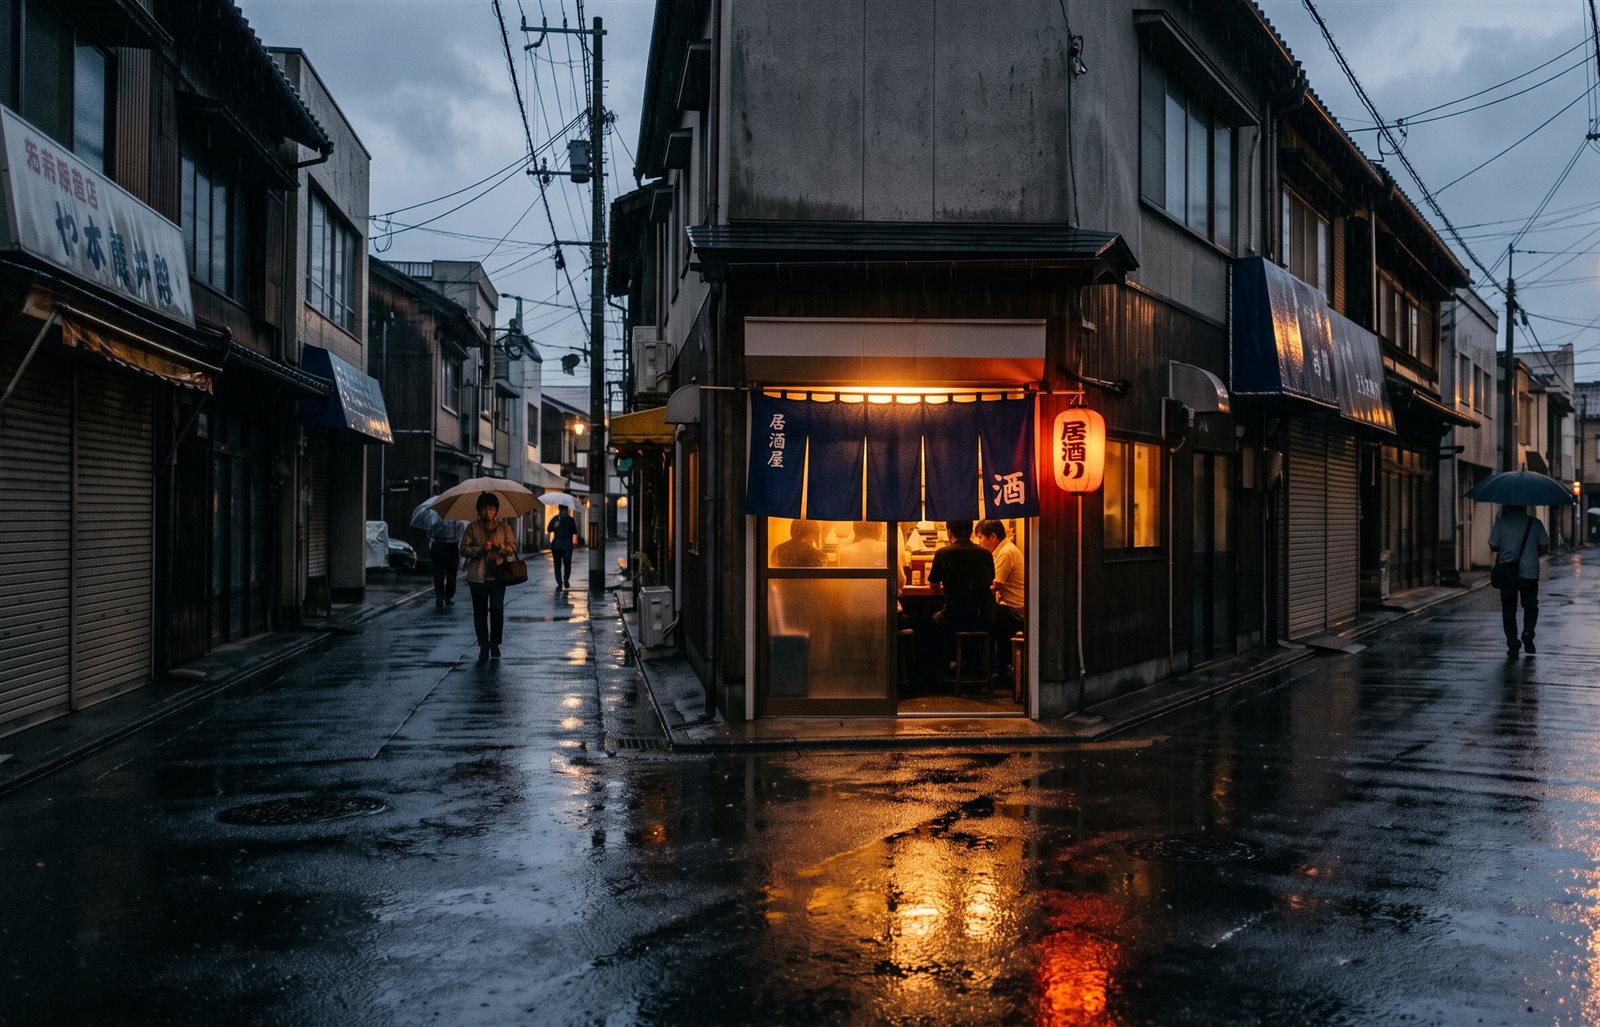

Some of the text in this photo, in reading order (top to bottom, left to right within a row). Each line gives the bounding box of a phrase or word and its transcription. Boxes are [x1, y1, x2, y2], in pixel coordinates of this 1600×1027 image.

[767, 413, 786, 468] 居酒屋
[1061, 420, 1087, 479] 居酒り
[992, 471, 1026, 507] 酒
